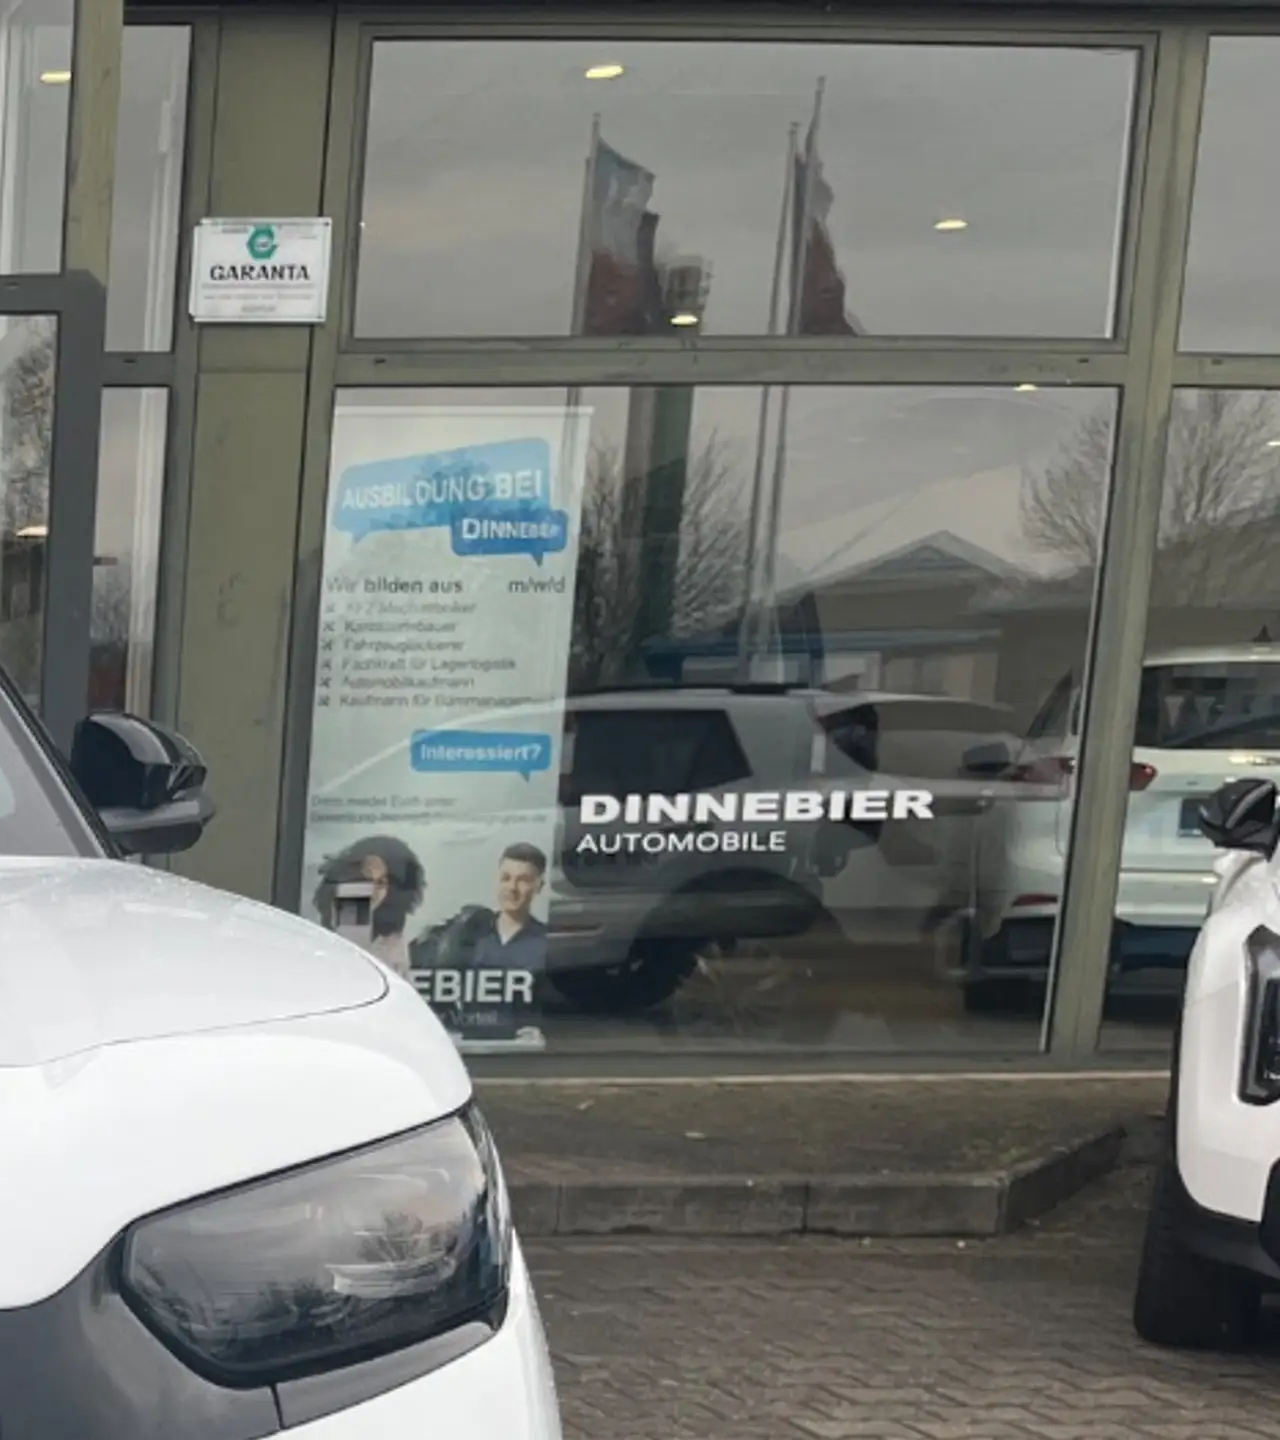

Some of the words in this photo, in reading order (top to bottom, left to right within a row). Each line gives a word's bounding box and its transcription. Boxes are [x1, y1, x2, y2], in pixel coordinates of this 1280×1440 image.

[209, 264, 310, 282] GARANTA
[494, 469, 542, 498] BEI
[363, 577, 424, 594] bilden
[428, 579, 463, 594] aus
[579, 788, 935, 825] DINNEBIER
[575, 830, 788, 854] AUTOMOBILE
